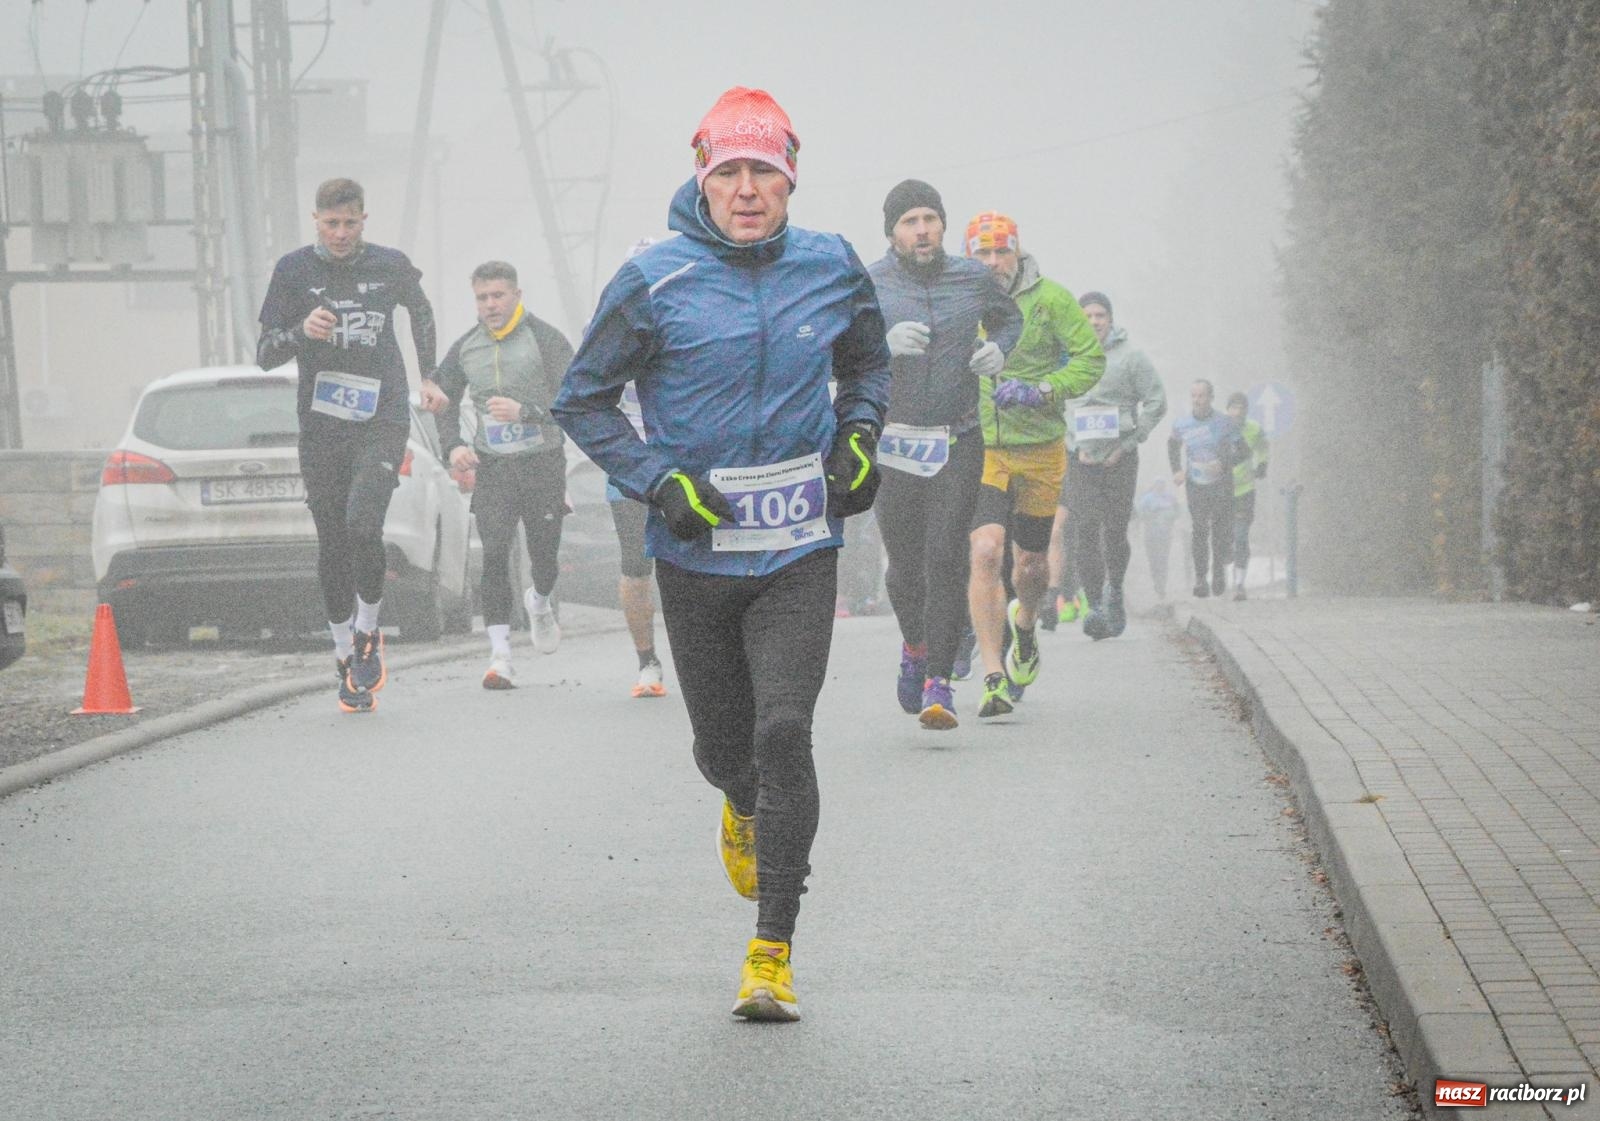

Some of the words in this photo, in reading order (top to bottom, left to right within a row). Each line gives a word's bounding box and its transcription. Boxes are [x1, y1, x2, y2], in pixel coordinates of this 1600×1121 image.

[331, 387, 360, 408] 43
[1087, 415, 1106, 429] 86
[501, 423, 524, 441] 69
[890, 437, 937, 461] 177
[214, 481, 238, 498] SK
[736, 484, 810, 528] 106
